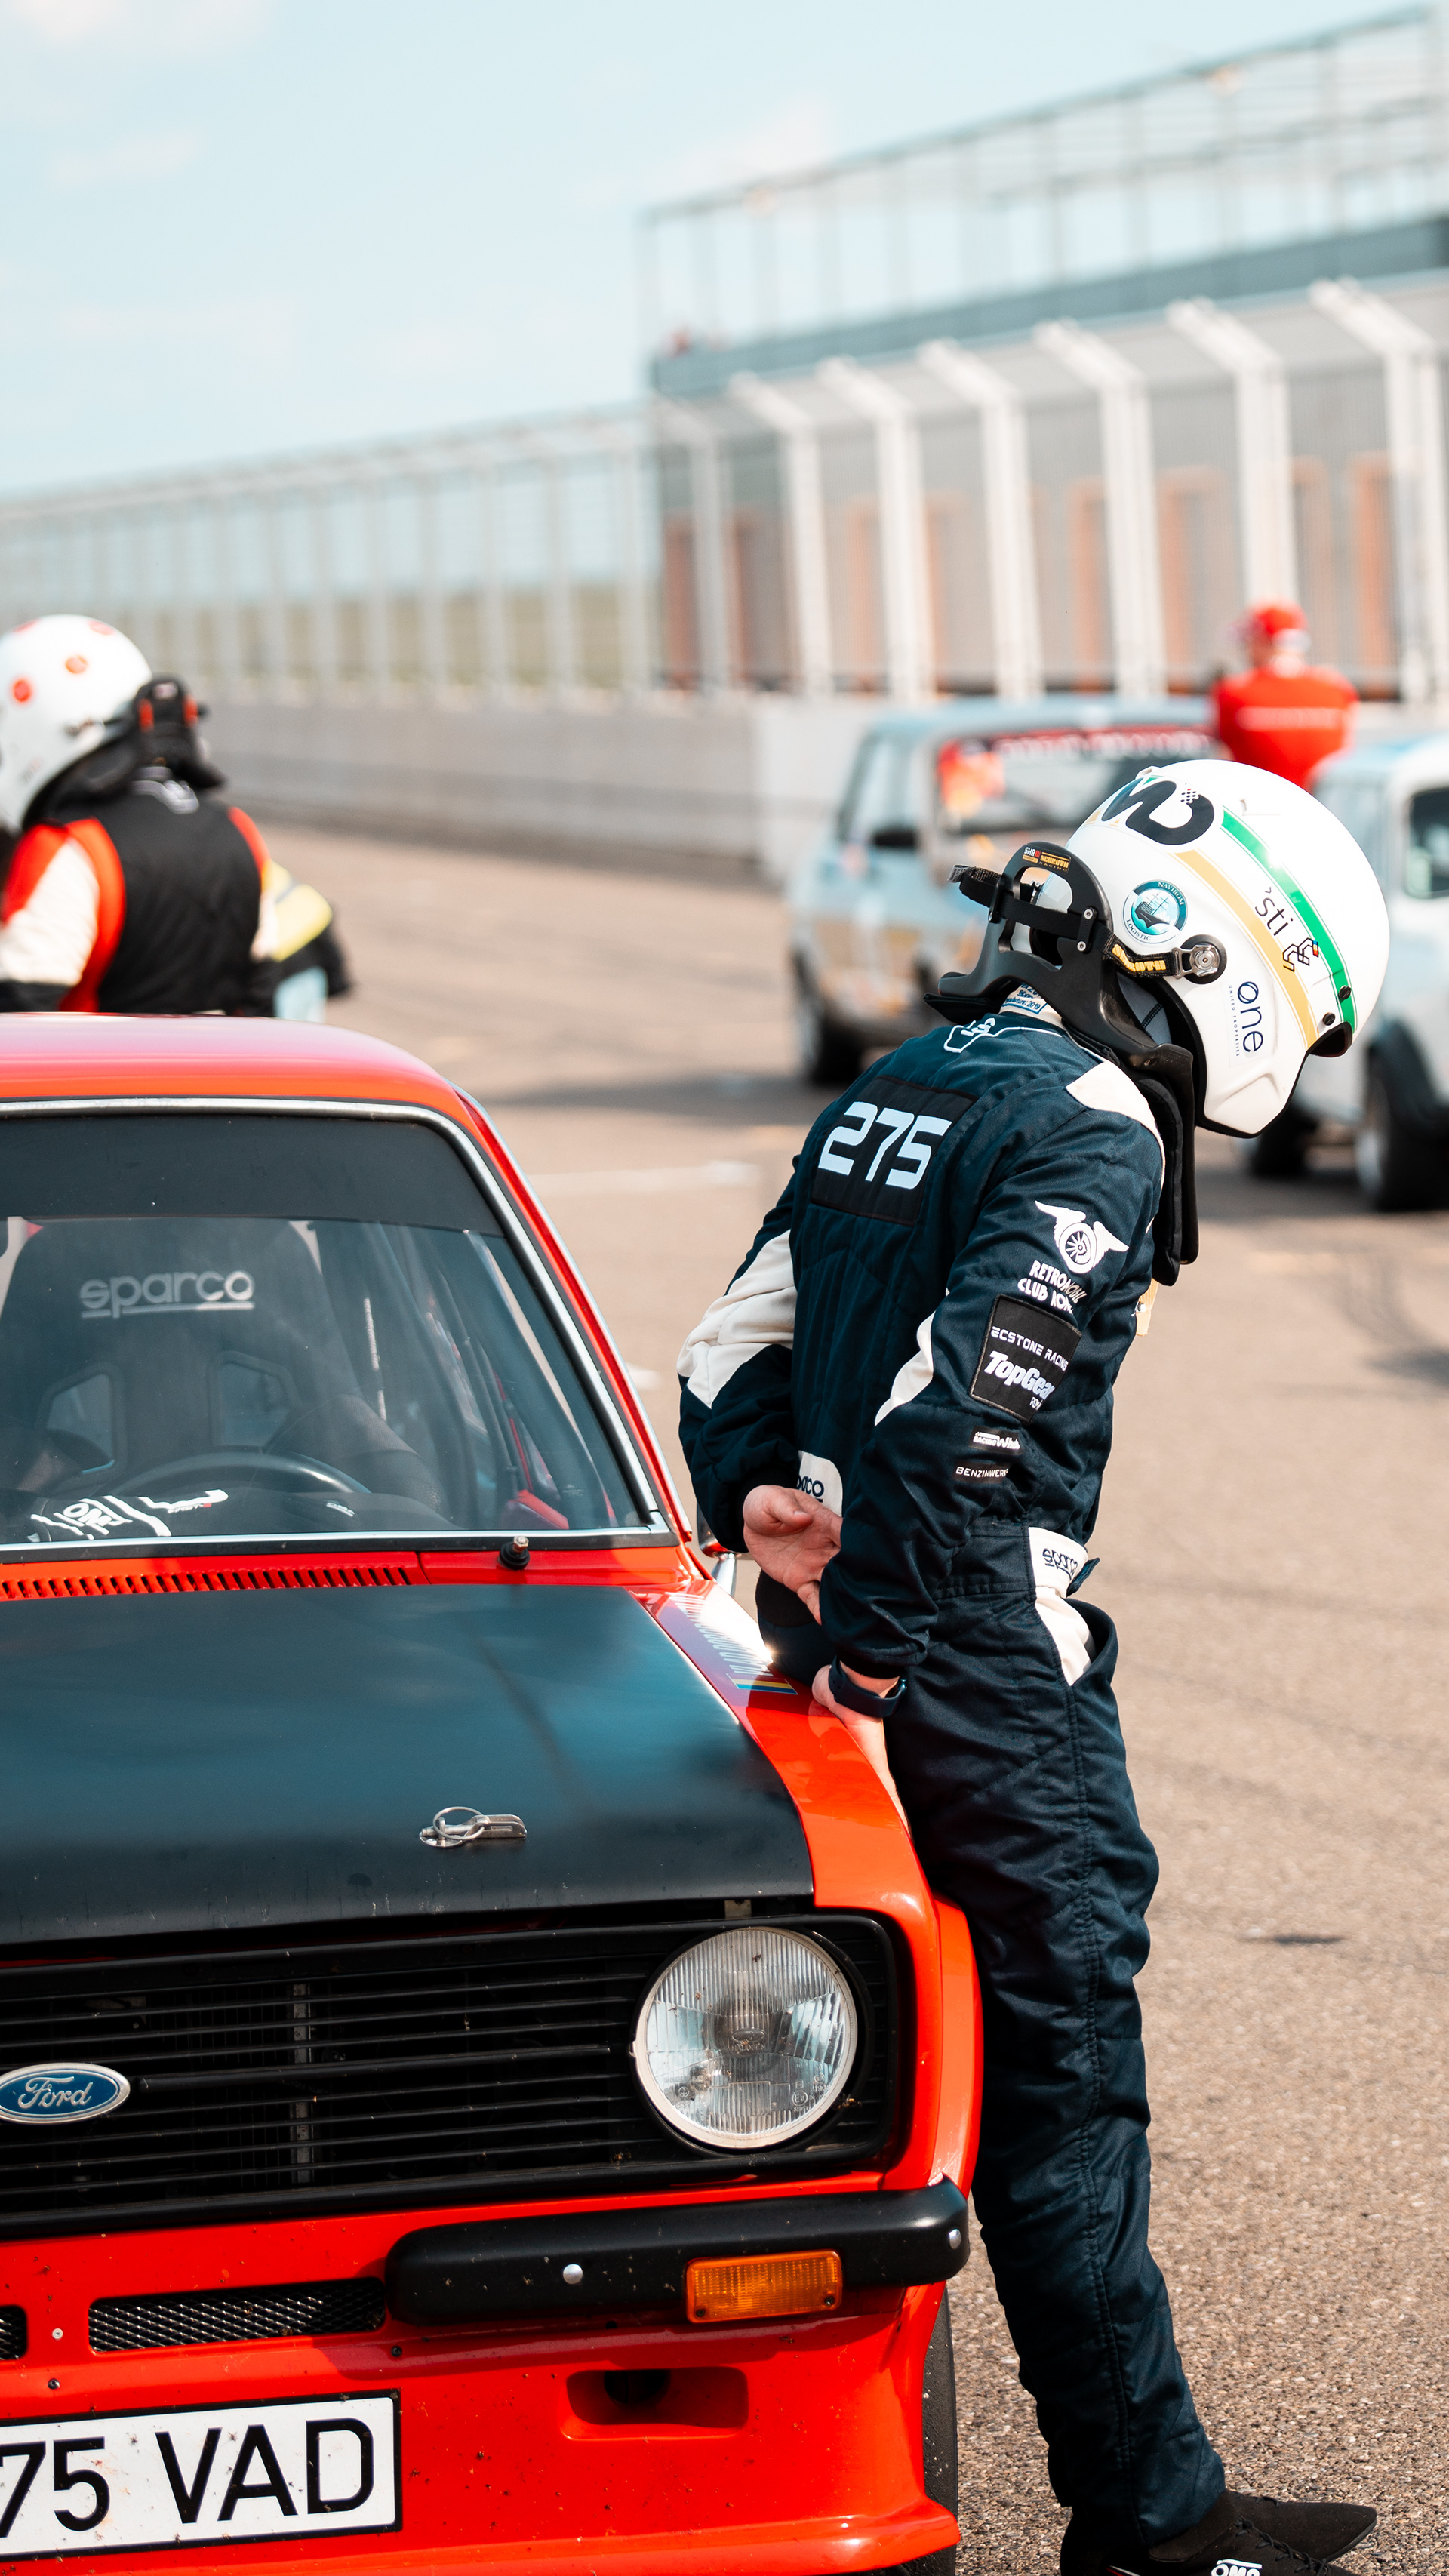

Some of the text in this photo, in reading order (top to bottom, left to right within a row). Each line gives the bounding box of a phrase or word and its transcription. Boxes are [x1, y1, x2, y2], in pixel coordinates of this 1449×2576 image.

[1038, 862, 1068, 872] RACING
[1040, 854, 1069, 869] SCHROTH
[1158, 882, 1185, 906] NAVIROM
[1126, 919, 1152, 942] LOGISTIC
[1027, 1000, 1041, 1010] 2019
[1237, 981, 1264, 1053] one
[817, 1101, 952, 1190] 275
[79, 1270, 255, 1319] sparco
[1017, 1277, 1048, 1302] CLUB
[990, 1326, 1069, 1371] ECSTONE RACING
[17, 2076, 93, 2109] Ford
[155, 2417, 375, 2525] VAD
